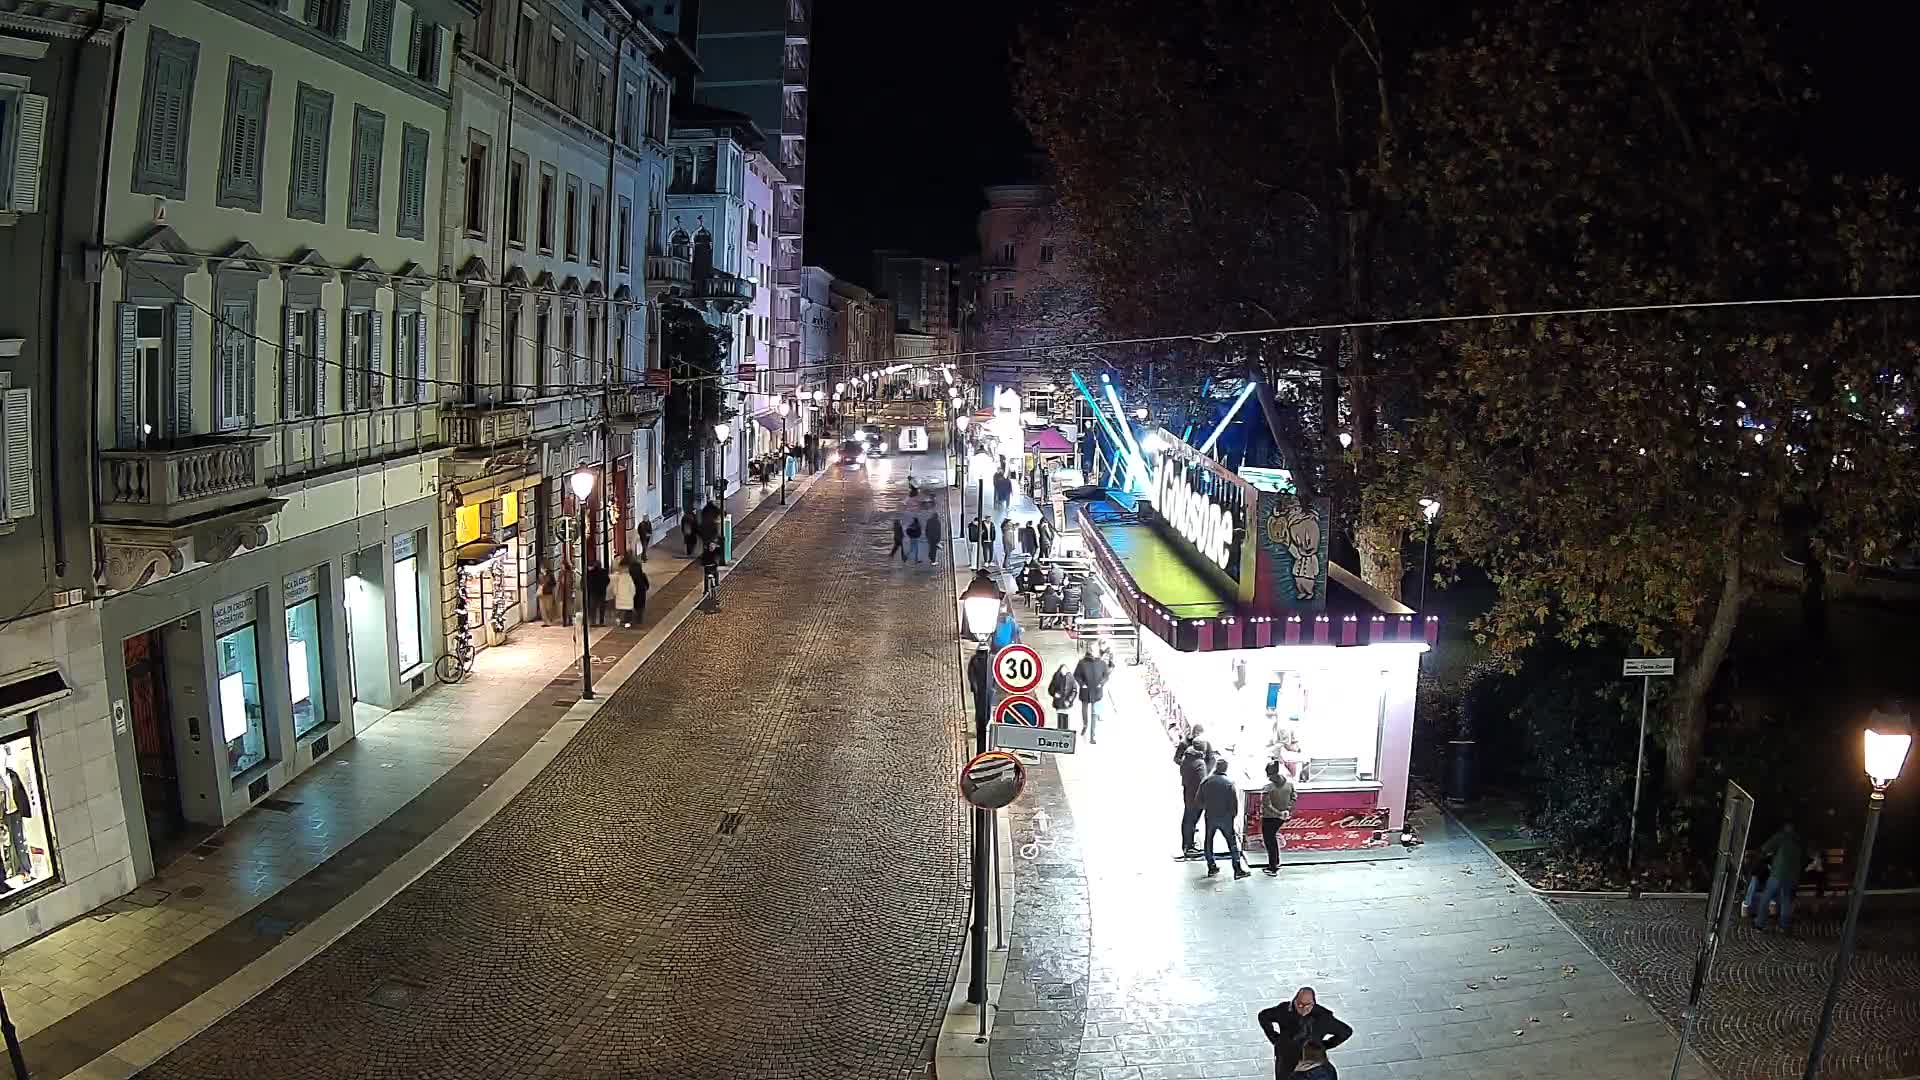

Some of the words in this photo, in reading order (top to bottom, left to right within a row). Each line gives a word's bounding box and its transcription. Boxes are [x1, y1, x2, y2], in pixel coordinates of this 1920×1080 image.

[233, 597, 254, 612] CREDITO
[1005, 658, 1033, 680] 30
[1038, 737, 1070, 749] Dante
